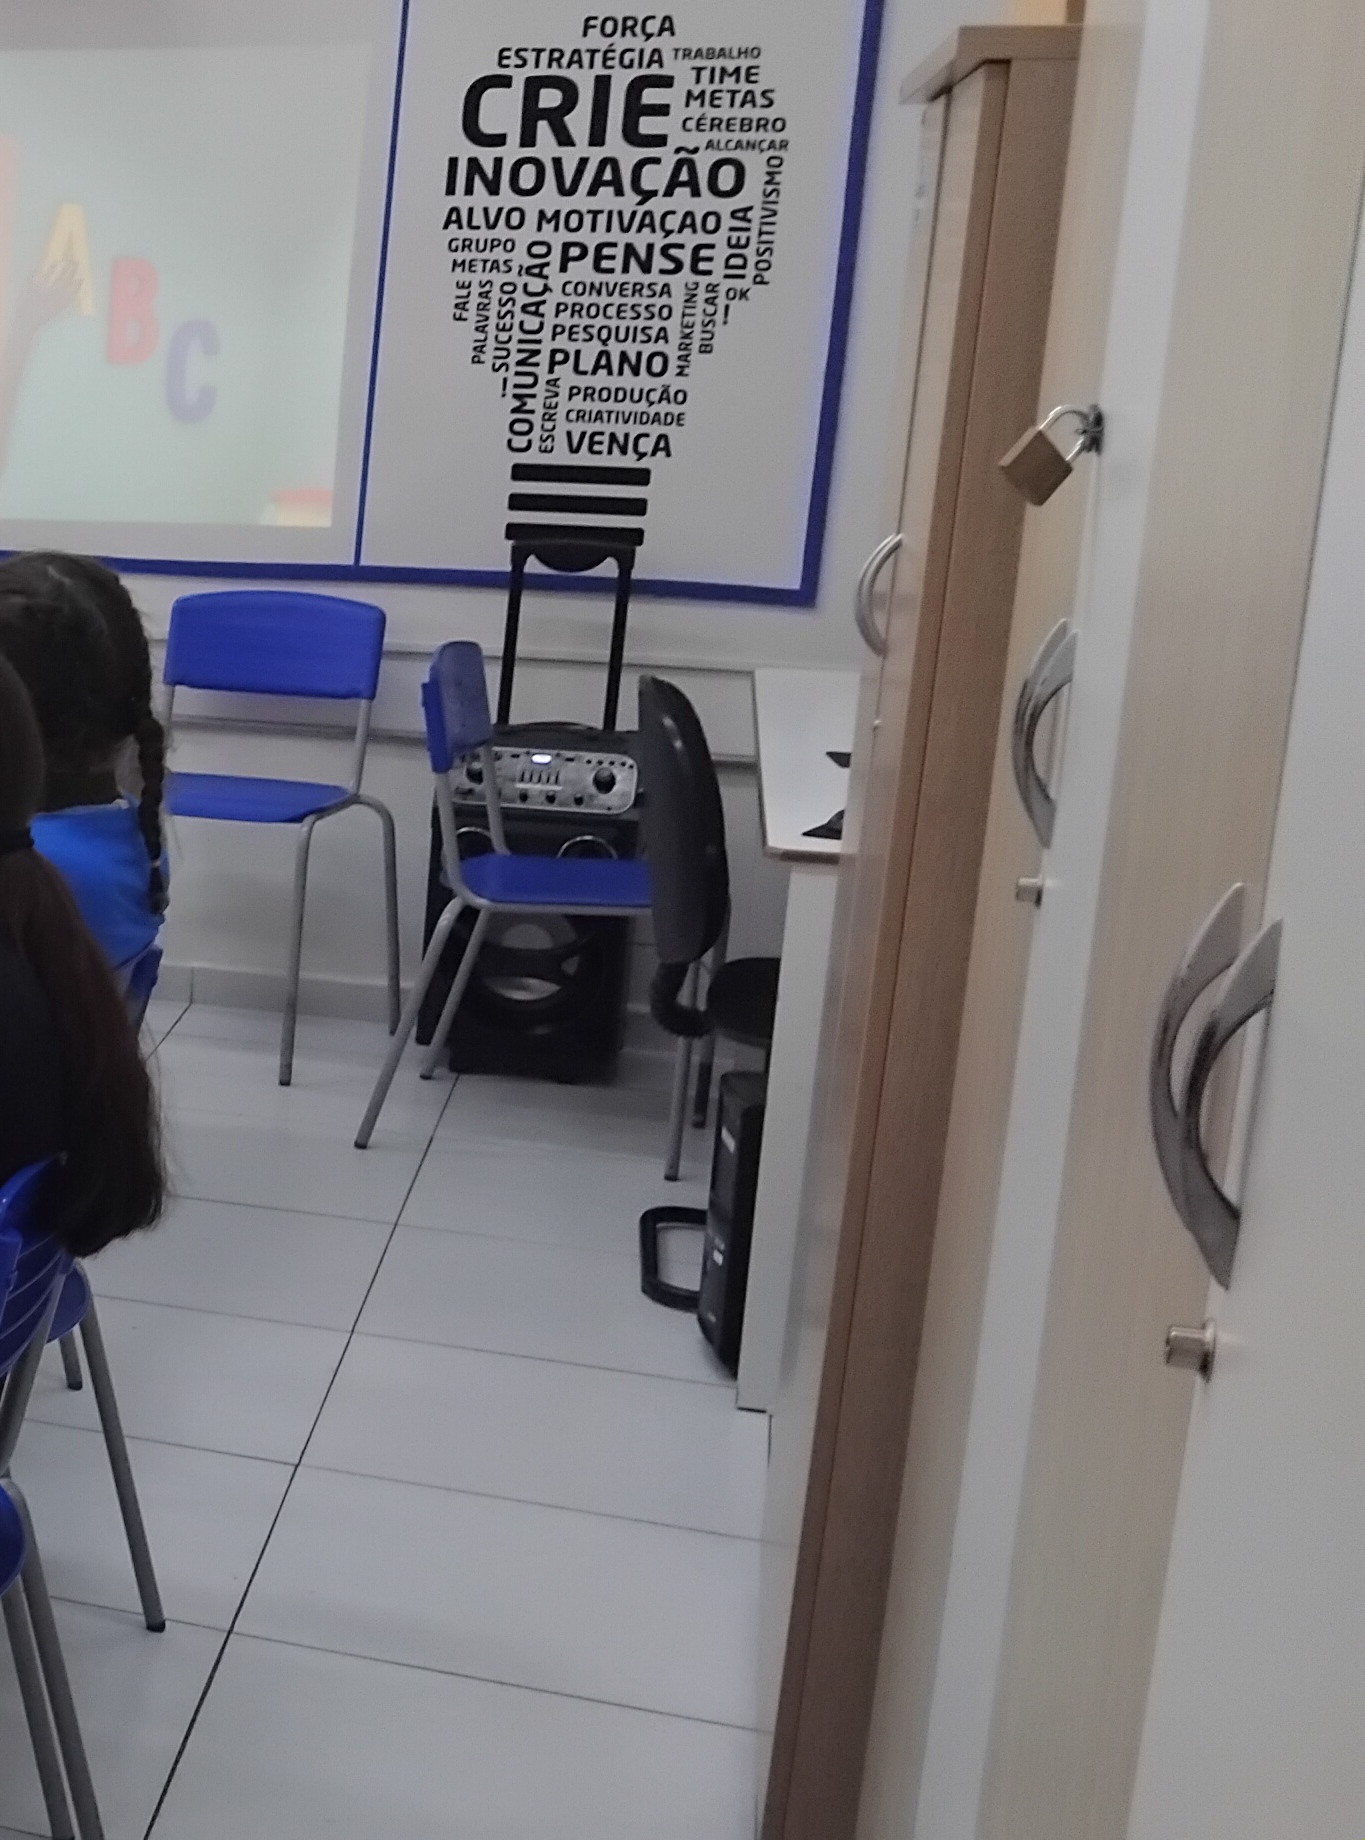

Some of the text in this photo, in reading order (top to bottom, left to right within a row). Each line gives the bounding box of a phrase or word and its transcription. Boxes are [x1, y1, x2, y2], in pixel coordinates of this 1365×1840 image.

[582, 15, 676, 42] FORÇA
[498, 43, 664, 70] ESTRATÉGIA
[673, 47, 761, 60] TRABALHO
[691, 65, 760, 85] TIME
[462, 74, 675, 148] CRIE
[685, 89, 775, 109] METAS
[682, 113, 786, 133] CÉREBRO
[704, 139, 789, 154] ALCANÇAR
[445, 146, 746, 206] INOVAÇÃO
[442, 206, 526, 230] ALVO
[536, 209, 722, 239] MOTIVAÇAO
[752, 156, 784, 285] POSITIVISMO
[448, 238, 516, 253] GRUPO
[723, 205, 754, 280] IDEIA
[452, 258, 513, 274] METAS
[559, 241, 716, 276] PENSE
[453, 281, 472, 321] FALE
[562, 281, 672, 298] CONVERSA
[725, 287, 751, 301] OK
[471, 280, 493, 364] PALAVRAS
[554, 302, 672, 321] PROCESSO
[698, 283, 720, 354] BUSCAR
[492, 282, 517, 372] SUCESSO
[551, 324, 669, 347] PESQUISA
[675, 282, 699, 377] MARKETING
[507, 239, 553, 454] COMUNICAÇÃO
[548, 348, 669, 378] PLANO
[568, 384, 687, 408] PRODUÇÃO
[538, 377, 561, 454] ESCREVA
[566, 409, 685, 427] CRIATIVIDADE
[566, 430, 672, 461] VENÇA
